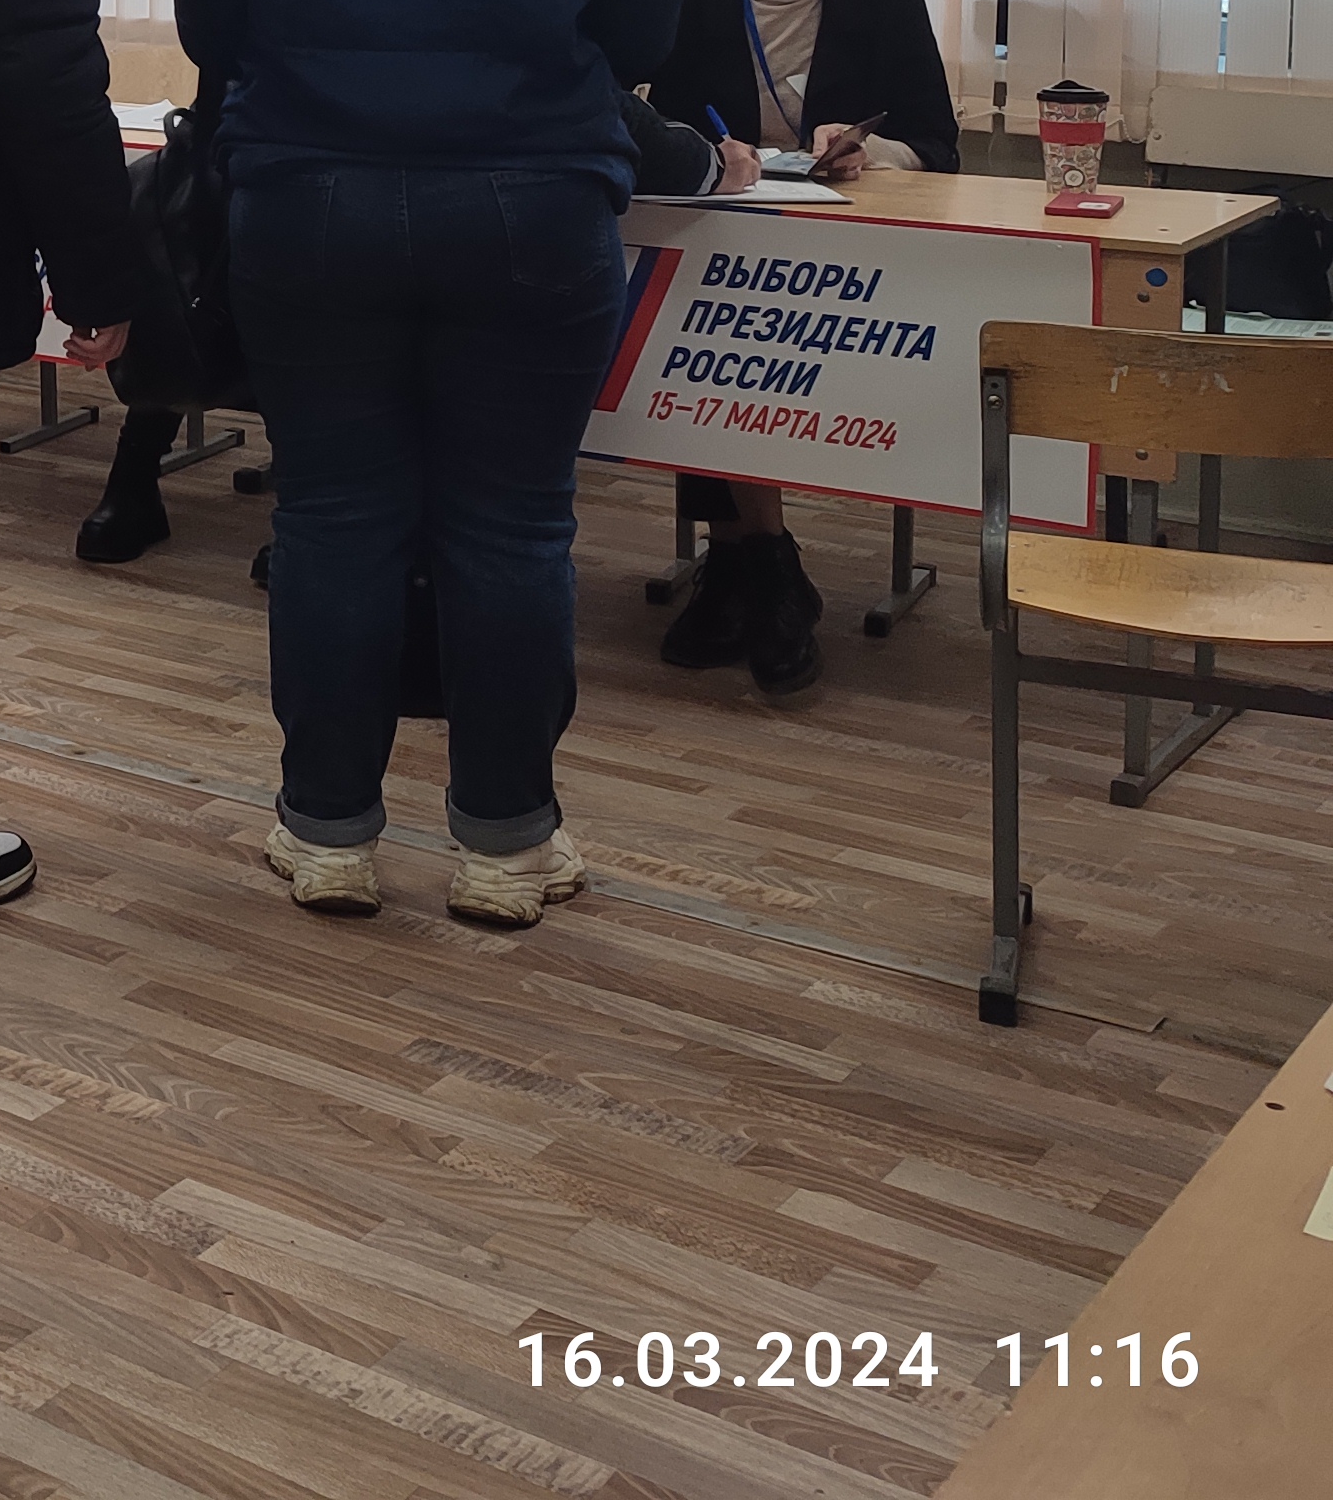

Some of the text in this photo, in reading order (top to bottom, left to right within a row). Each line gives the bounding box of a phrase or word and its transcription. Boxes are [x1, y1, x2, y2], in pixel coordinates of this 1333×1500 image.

[700, 252, 883, 303] ВЫБОРЫ
[680, 299, 937, 361] ПРЕЗИДЕНТА
[661, 346, 823, 397] РОССИИ
[723, 401, 821, 442] МАРТА
[824, 415, 897, 451] 2024
